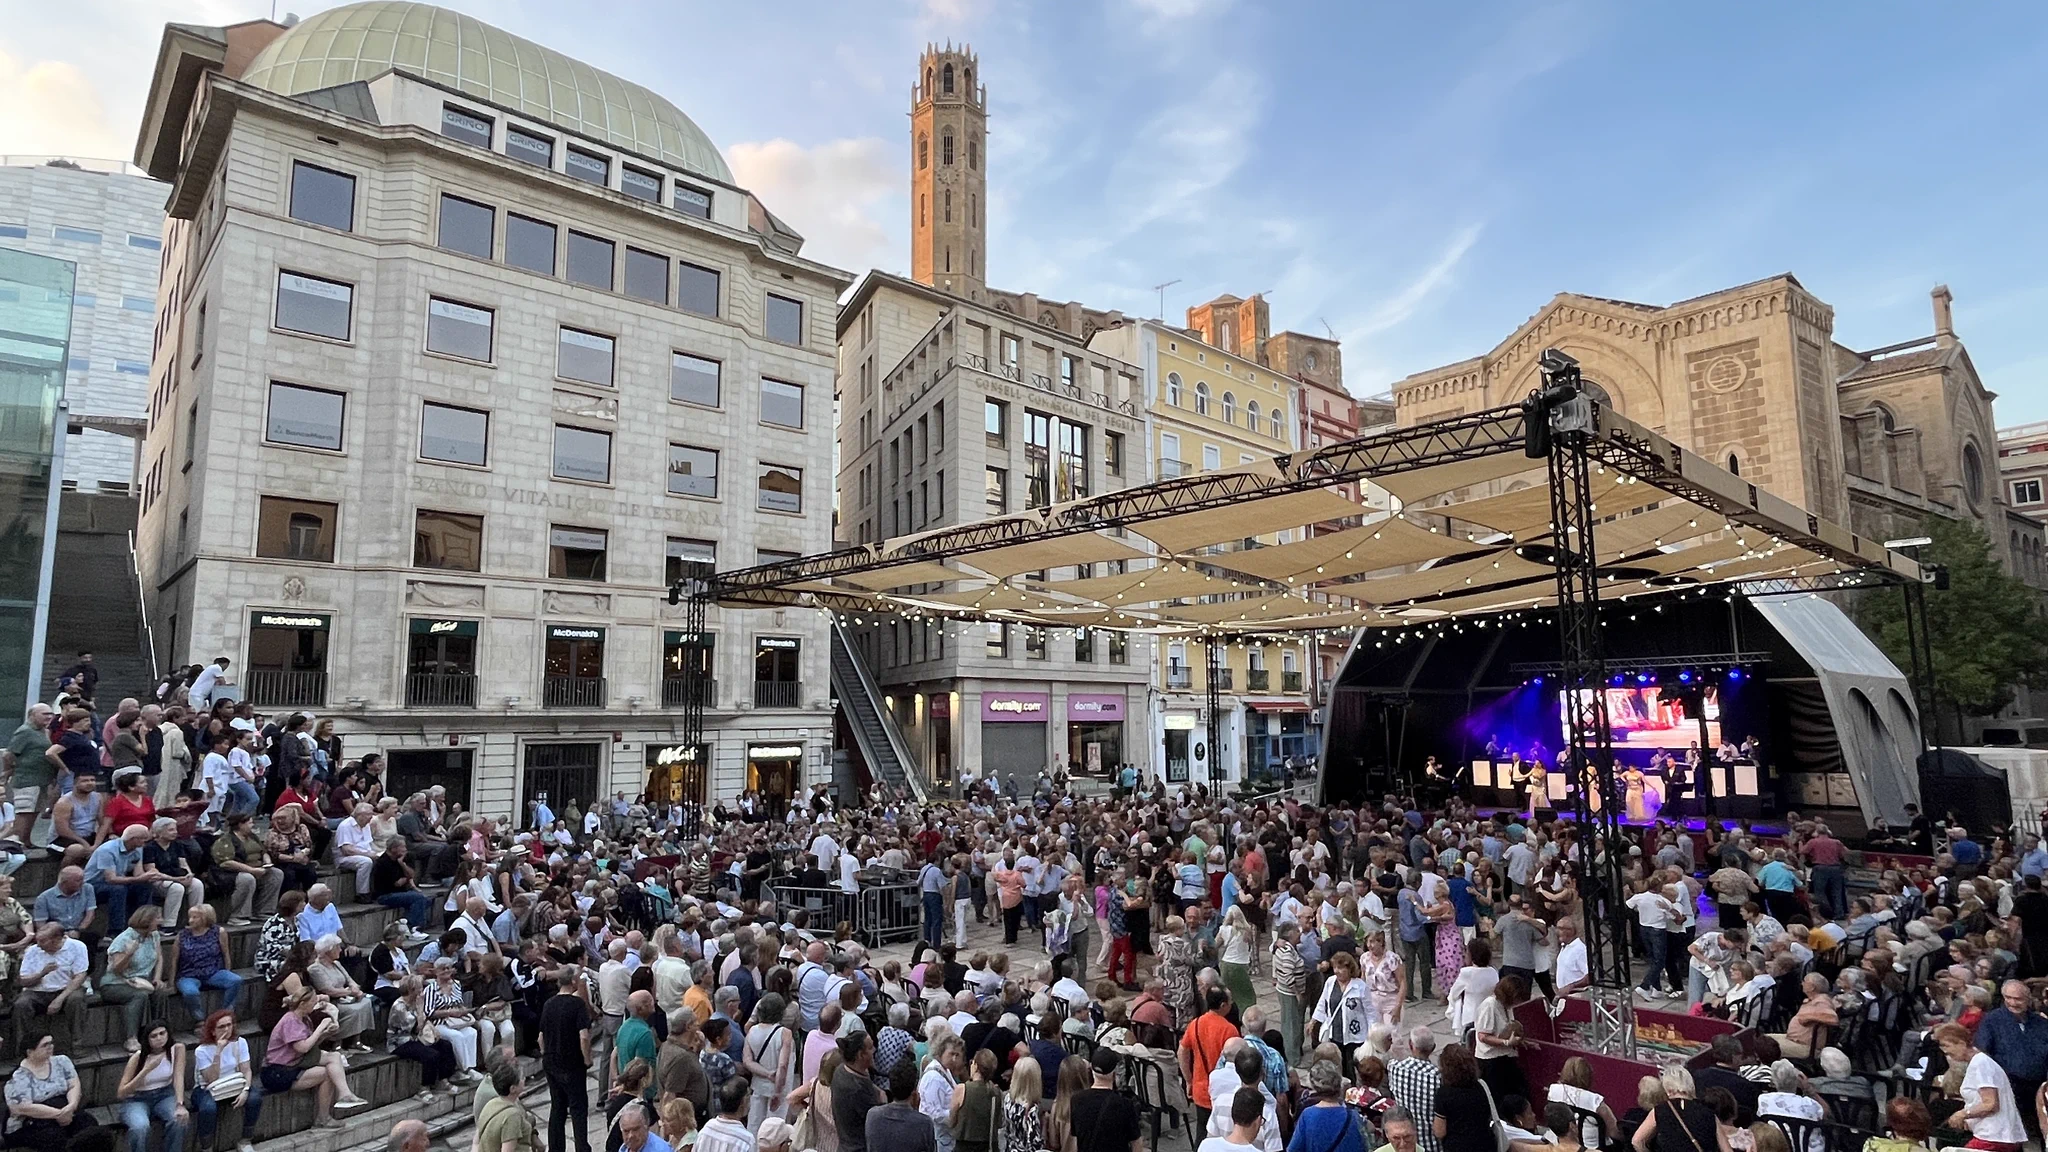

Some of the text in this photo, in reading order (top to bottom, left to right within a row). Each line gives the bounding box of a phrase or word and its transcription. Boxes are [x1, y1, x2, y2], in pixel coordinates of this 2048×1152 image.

[975, 377, 1022, 400] CONSELL
[1085, 408, 1101, 423] DEL
[617, 502, 641, 517] DE
[261, 615, 323, 627] McDonald's
[552, 628, 599, 639] McDonald's
[1074, 701, 1117, 713] dormity.com
